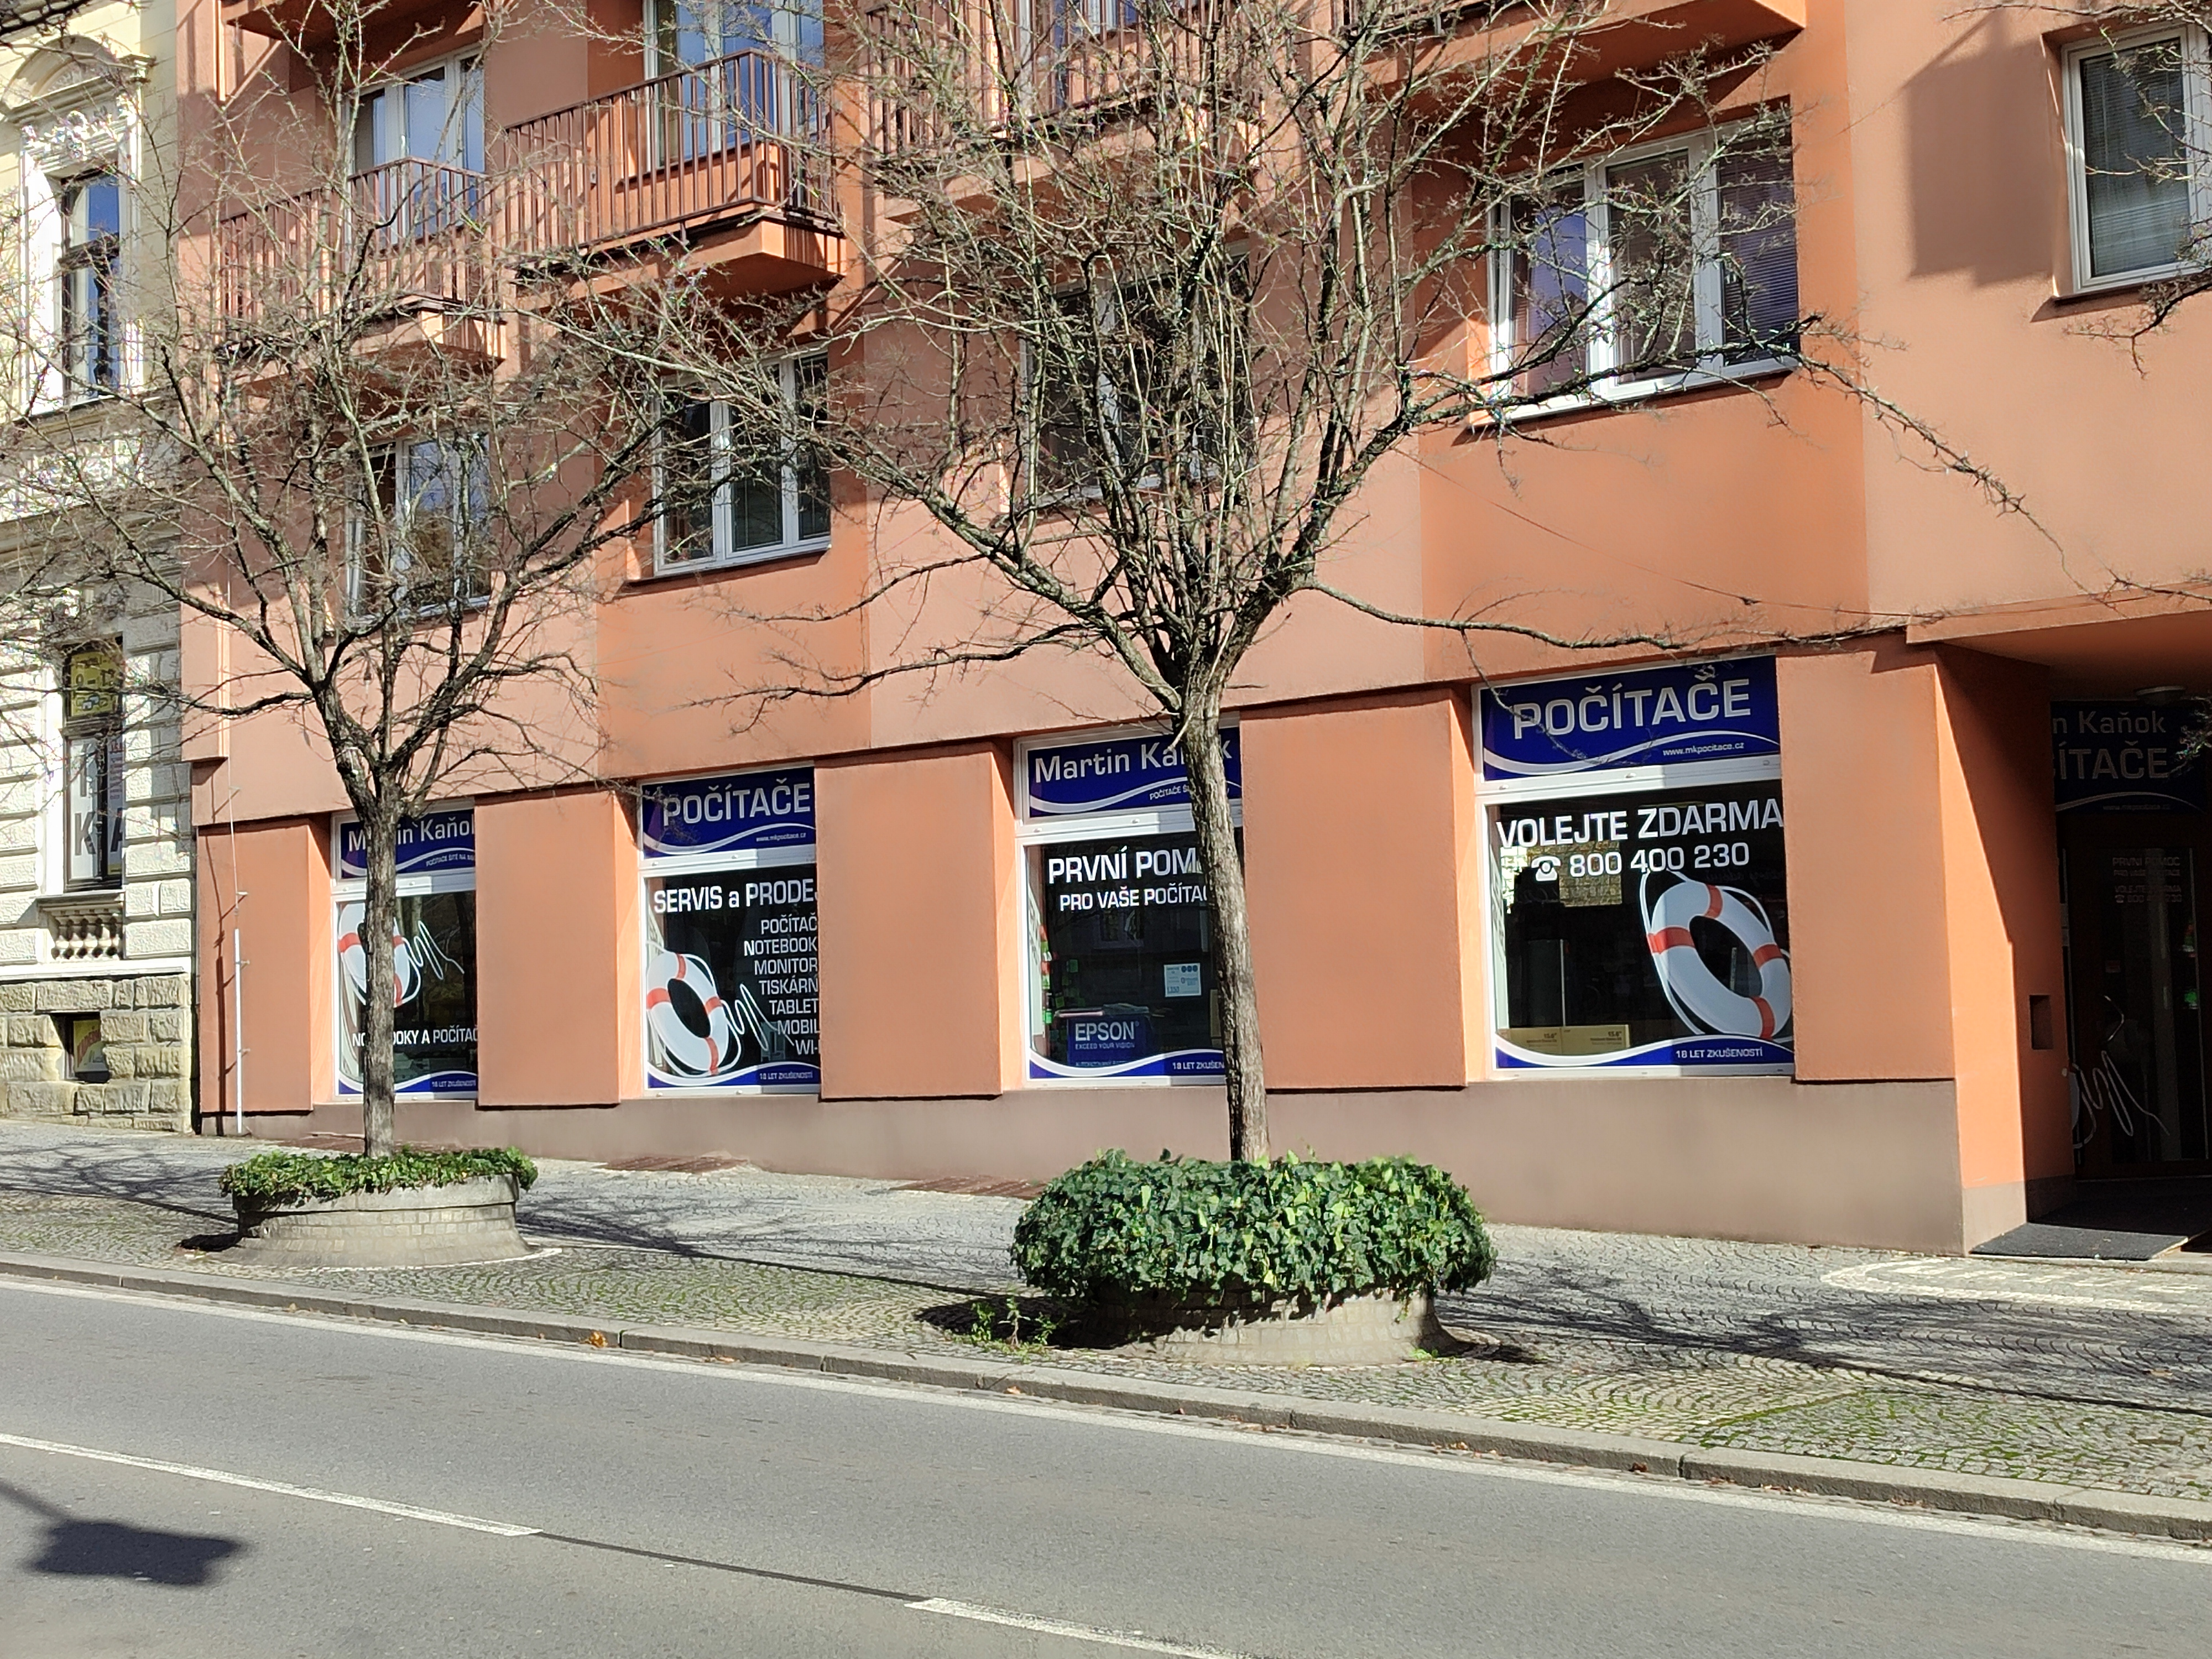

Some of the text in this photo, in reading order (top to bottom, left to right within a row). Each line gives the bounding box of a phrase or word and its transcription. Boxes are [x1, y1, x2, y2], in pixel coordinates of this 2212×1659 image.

[1513, 674, 1751, 739] POČÍTAČE
[2079, 711, 2166, 734] Kaňok
[1663, 742, 1744, 756] www.mkpocitace.cz
[1035, 748, 1130, 783] Martin
[664, 778, 811, 826] POČÍTAČE
[421, 815, 474, 842] Kaňo
[1496, 799, 1783, 848] VOLEJTE ZDARMA
[1048, 846, 1128, 884] PRVNÍ
[1569, 842, 1749, 877] 800 400 230
[654, 879, 817, 913] SERVIS a PRODE
[1060, 893, 1093, 911] PRO
[1097, 886, 1139, 909] VAŠE
[744, 936, 817, 956] NOTEBOOK
[754, 957, 818, 975] MONITOR
[759, 975, 818, 995] TISKÁRN
[769, 998, 819, 1015] TABLET
[421, 1029, 430, 1044] A
[777, 1019, 821, 1035] MOBIL
[1075, 1021, 1134, 1041] EPSON
[1676, 1047, 1763, 1058] 18 LET ZKUŠENOSTÍ
